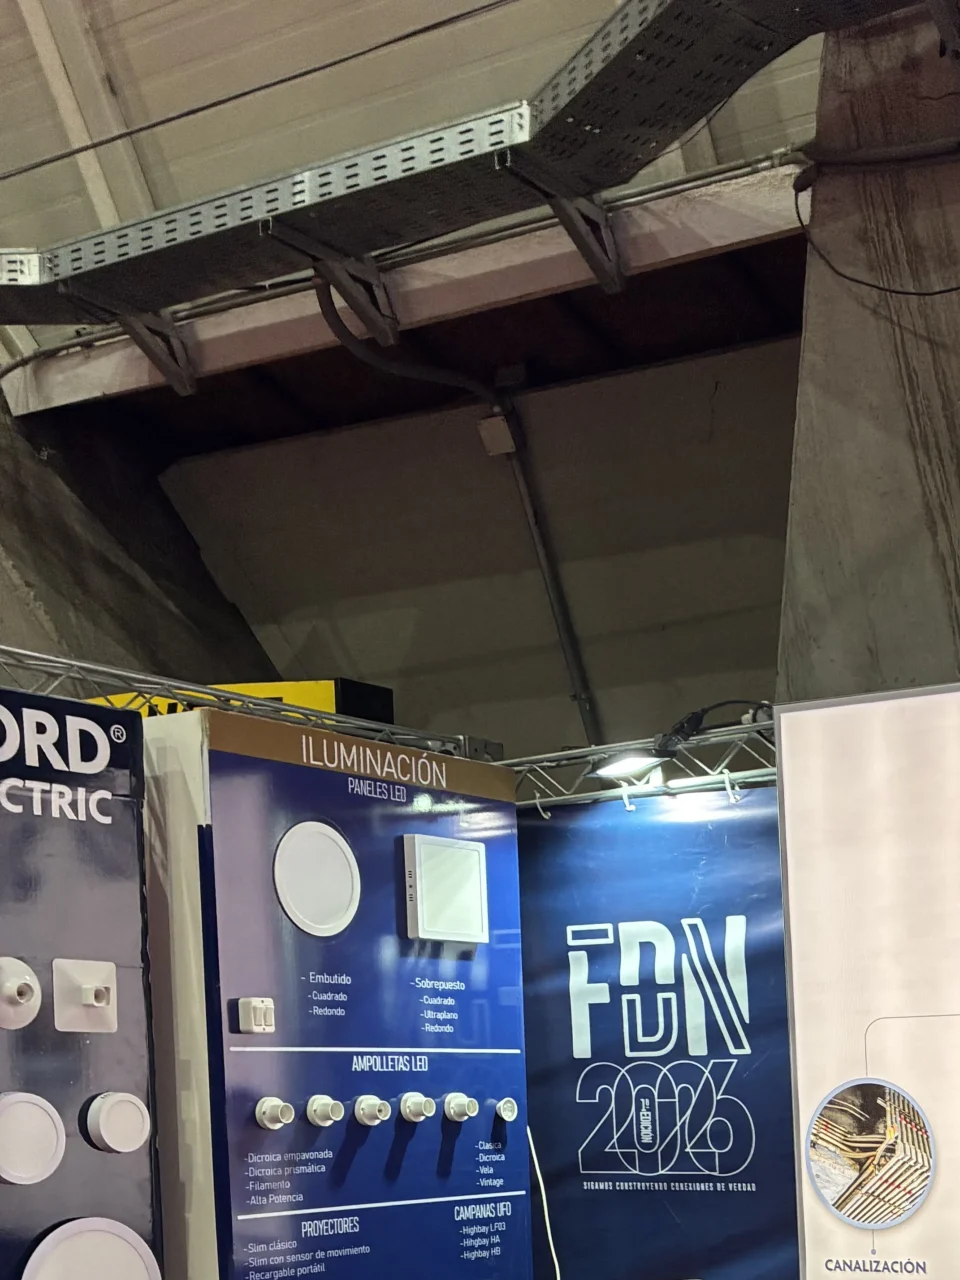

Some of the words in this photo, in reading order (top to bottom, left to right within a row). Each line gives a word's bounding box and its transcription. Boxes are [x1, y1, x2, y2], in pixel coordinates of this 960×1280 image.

[302, 735, 446, 788] ILUMINACIÓN
[348, 777, 388, 800] PANELES
[390, 785, 406, 802] LED
[0, 777, 112, 824] CTRIC
[309, 972, 351, 985] Embutido
[352, 1056, 410, 1072] AMPOLLETAS
[412, 1056, 428, 1072] LED
[576, 1059, 755, 1176] 2026
[284, 1149, 333, 1161] empavonada
[285, 1162, 326, 1176] prismática
[583, 1182, 613, 1190] SIGAMOS
[670, 1182, 714, 1191] CONEXIONES
[717, 1183, 725, 1191] DE
[729, 1183, 756, 1191] VERDAD
[268, 1192, 303, 1204] Potencia
[454, 1203, 495, 1221] CAMPANAS
[497, 1202, 512, 1216] UFO
[302, 1217, 359, 1238] PROYECTORES
[269, 1239, 297, 1251] clásico
[270, 1255, 284, 1264] con
[286, 1252, 313, 1262] sensor
[315, 1249, 325, 1259] de
[327, 1245, 370, 1257] movimiento
[297, 1263, 325, 1277] portátil
[825, 1257, 927, 1274] CANALIZACIÓN
